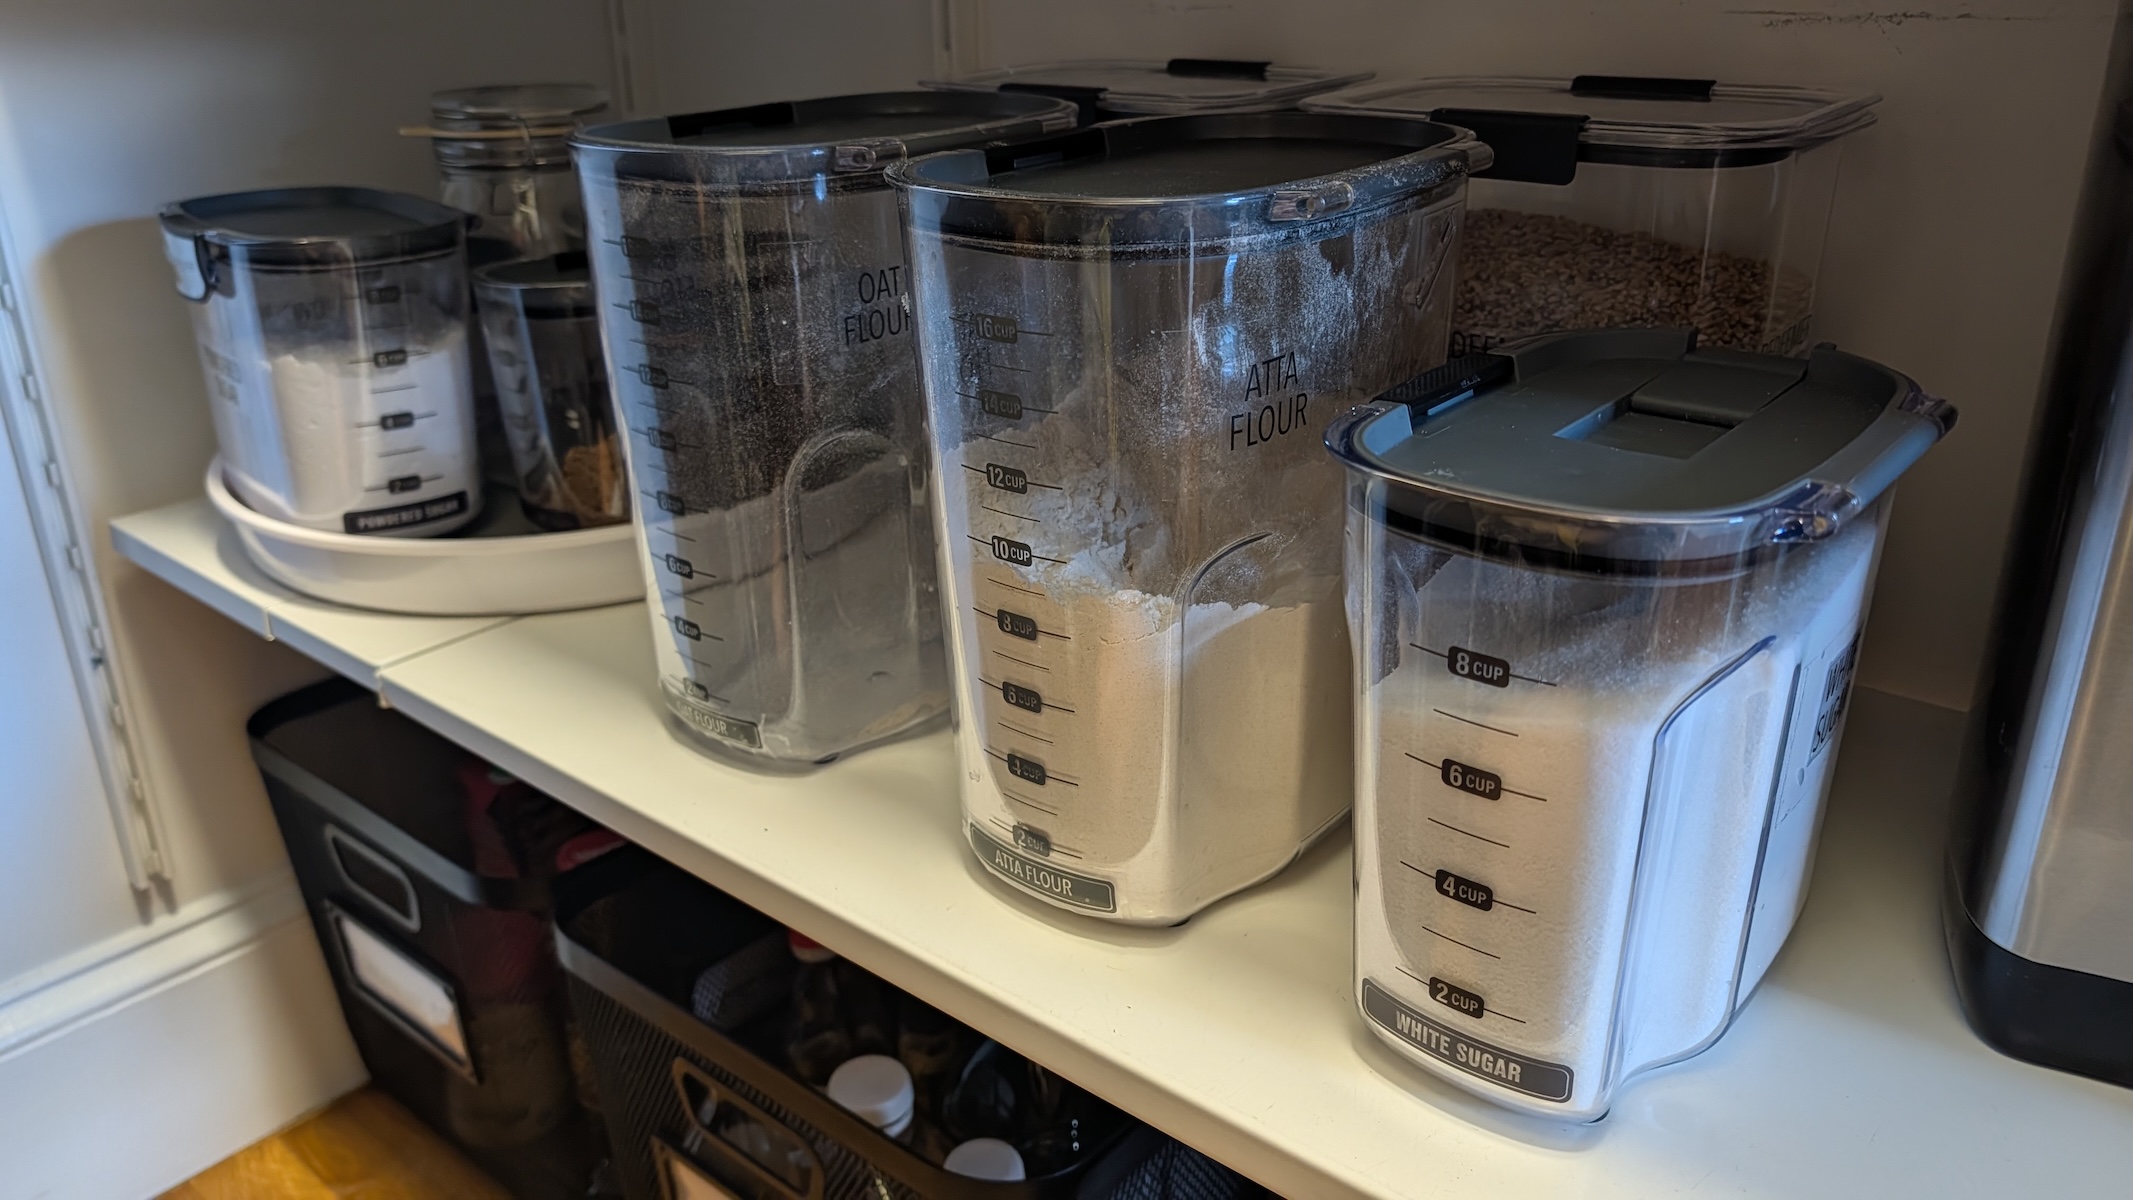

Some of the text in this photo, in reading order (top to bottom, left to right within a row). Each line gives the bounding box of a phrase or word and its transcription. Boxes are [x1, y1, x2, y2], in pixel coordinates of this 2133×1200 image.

[858, 266, 900, 304] OAT
[977, 318, 1016, 339] 16 CUP
[1244, 351, 1299, 402] ATTA
[984, 395, 1020, 414] 14 CUP
[1230, 393, 1308, 450] FLOUR
[988, 466, 1025, 489] 12 CUP
[993, 538, 1030, 562] 10 CUP
[669, 558, 691, 575] 6 CUP
[678, 621, 698, 637] 4 CUP
[1003, 615, 1032, 635] 8 CUP
[1455, 653, 1503, 681] 8 CUP
[1008, 688, 1037, 708] 6 CUP
[694, 710, 729, 737] FLOUR
[1023, 766, 1042, 780] CUP
[1449, 765, 1495, 794] 6 CUP
[1017, 833, 1026, 848] 2
[995, 849, 1073, 897] ATTA FLOUR
[1442, 877, 1488, 905] 4 CUP
[1435, 983, 1479, 1012] 2 CUP
[1395, 1011, 1521, 1083] WHITE SUGAR
